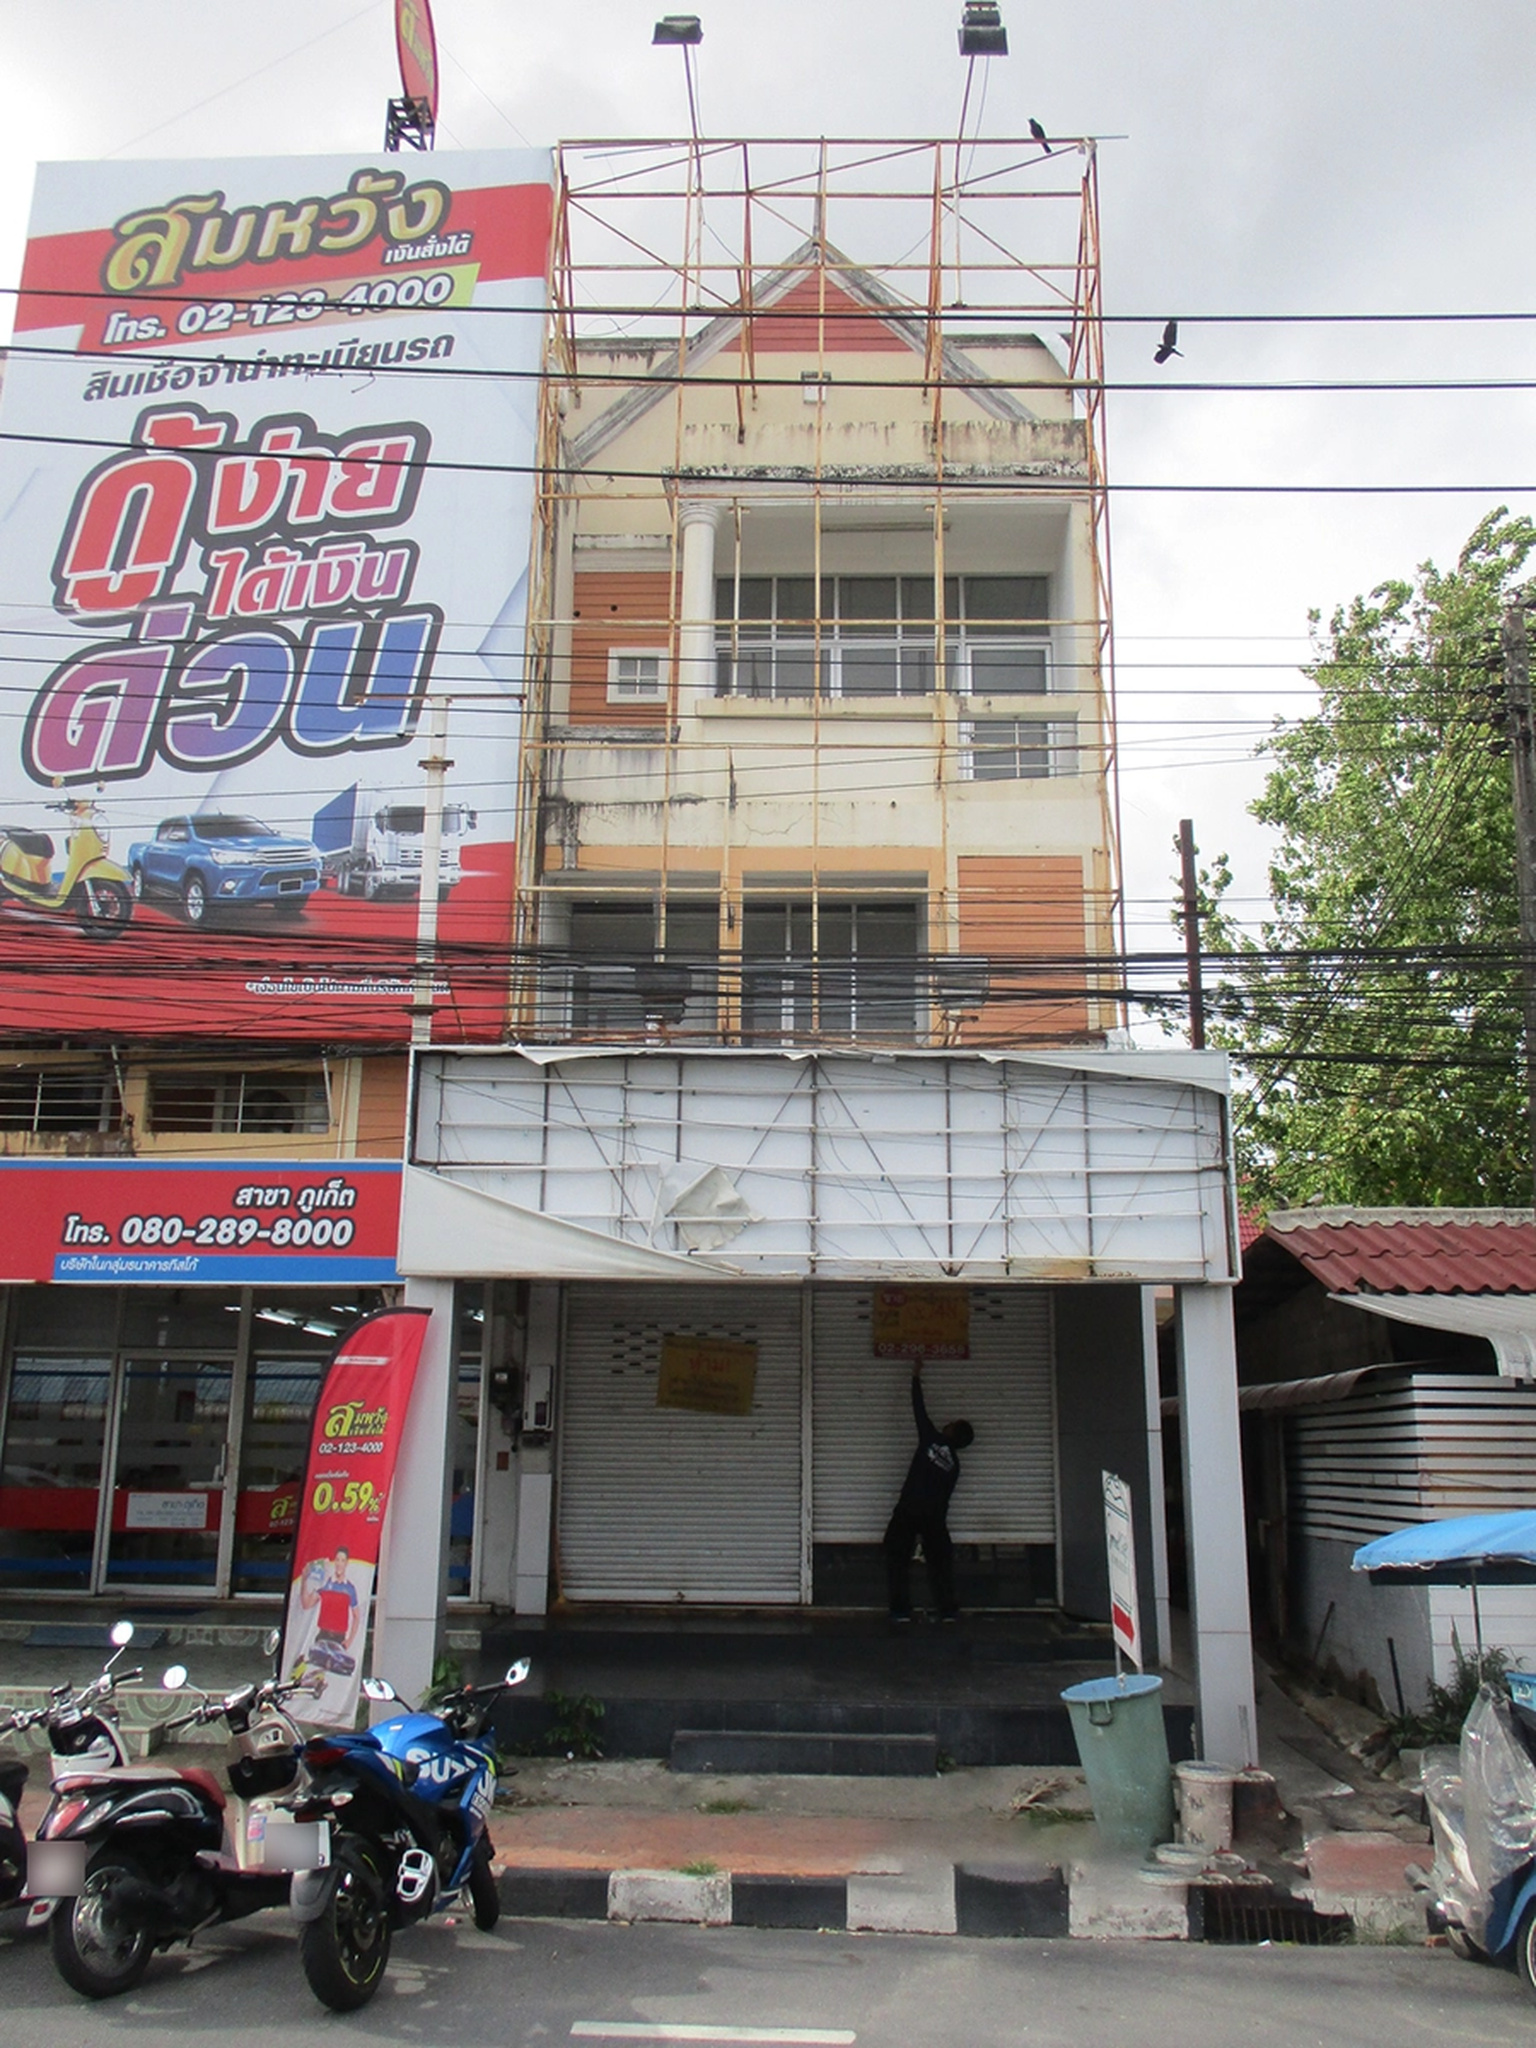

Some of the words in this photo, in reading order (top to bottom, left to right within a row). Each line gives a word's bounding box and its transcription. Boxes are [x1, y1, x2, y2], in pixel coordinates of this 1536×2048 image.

[104, 169, 450, 292] สมหวัง
[384, 233, 472, 265] เงินสั่งได้
[103, 311, 167, 346] โทร.
[177, 274, 454, 335] 02-123-4000
[58, 408, 424, 616] กู้ง่าย
[206, 542, 411, 621] ได้เงิน
[30, 602, 436, 777] ด่วน
[63, 1215, 111, 1246] โทร.
[121, 1217, 355, 1248] 080-289-8000
[235, 1185, 291, 1208] สาขา
[298, 1179, 356, 1214] ภูเก็ต
